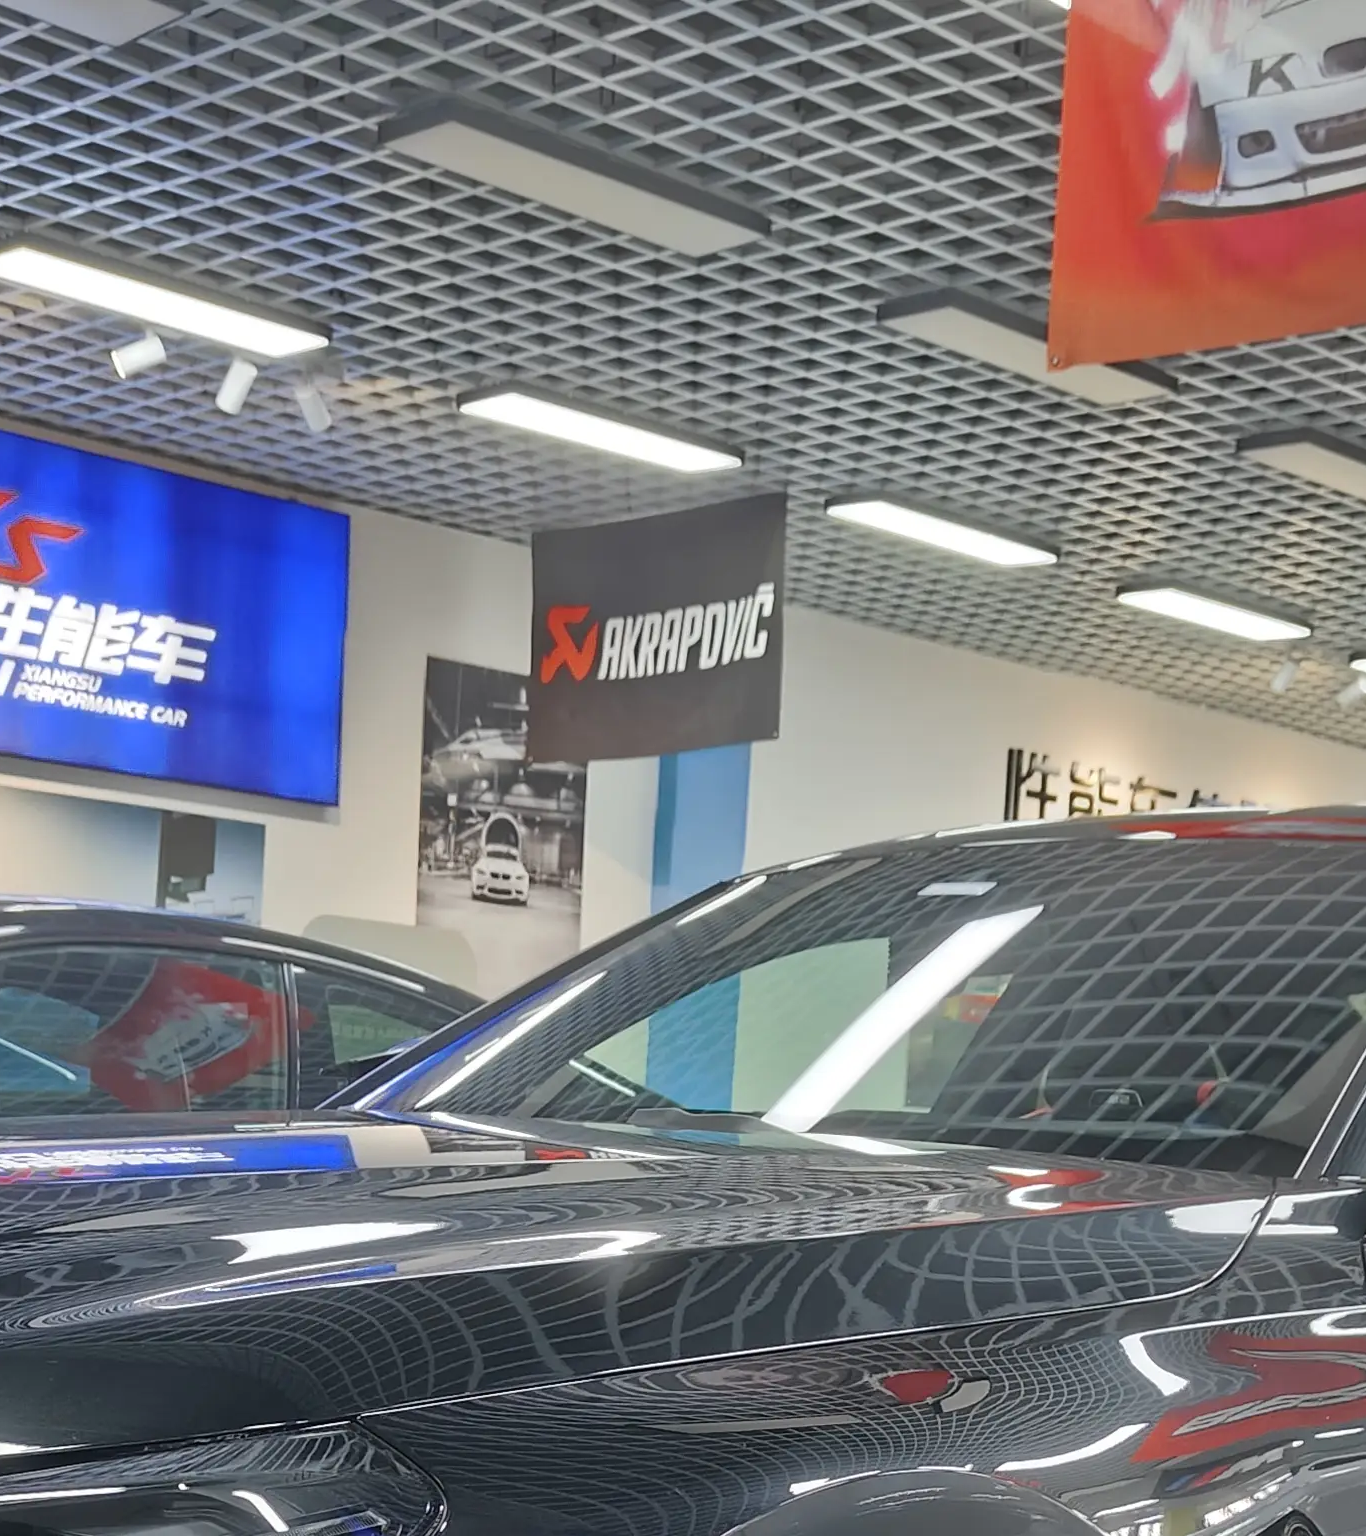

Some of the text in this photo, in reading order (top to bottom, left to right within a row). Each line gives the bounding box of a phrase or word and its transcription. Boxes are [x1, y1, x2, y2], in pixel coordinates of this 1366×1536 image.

[1247, 52, 1296, 98] K
[21, 663, 102, 693] XIANGSU
[13, 681, 188, 728] PERFORMANCE CAR
